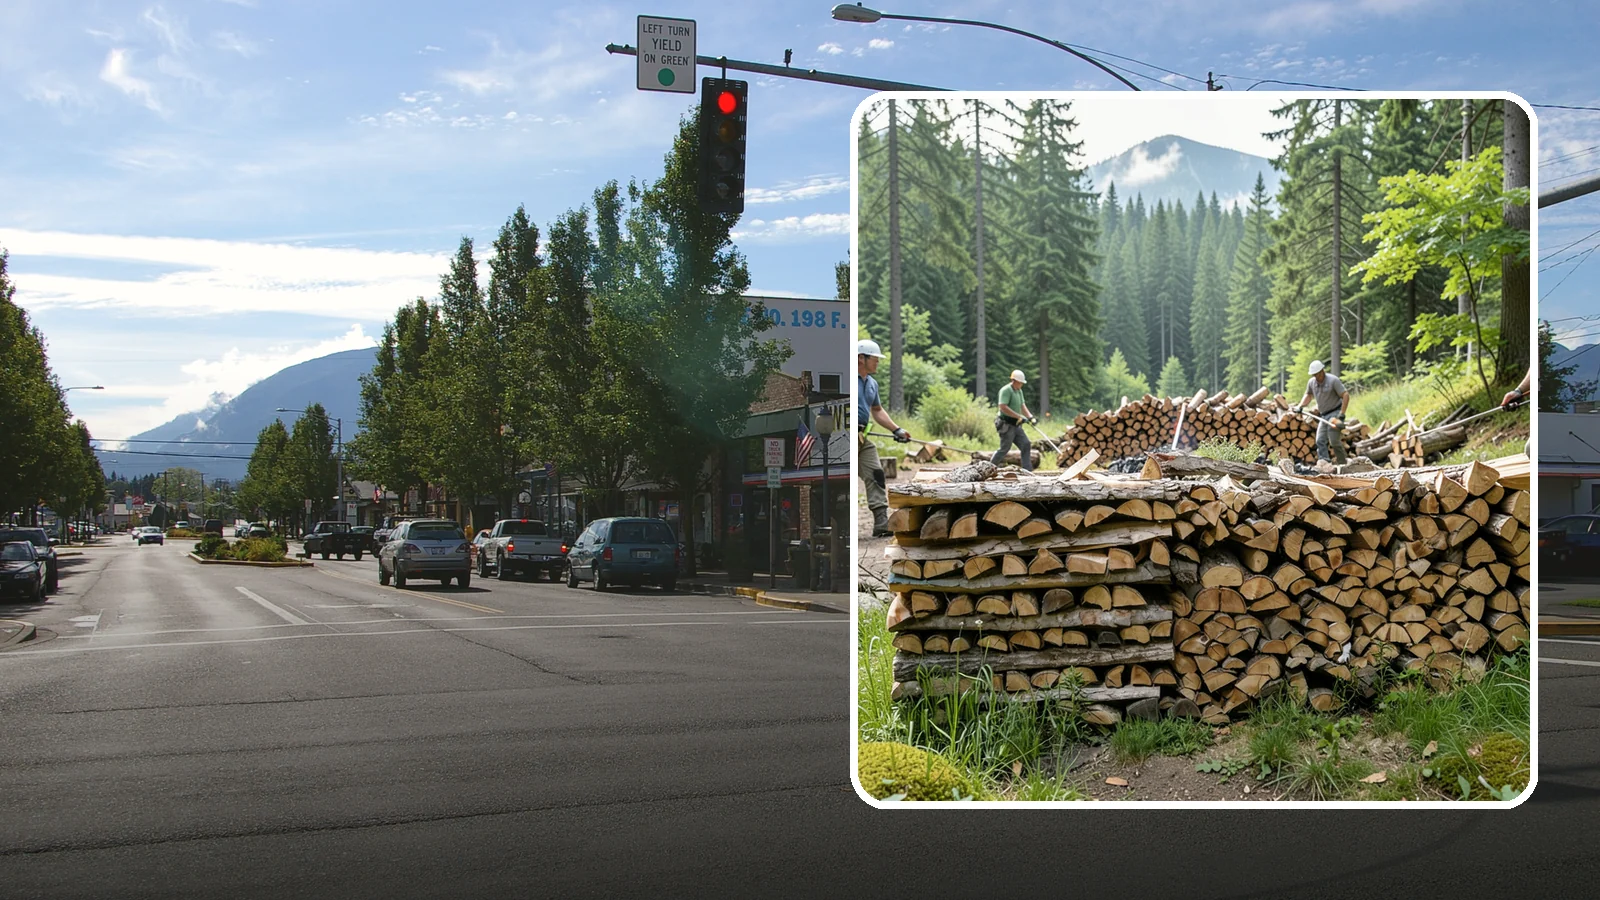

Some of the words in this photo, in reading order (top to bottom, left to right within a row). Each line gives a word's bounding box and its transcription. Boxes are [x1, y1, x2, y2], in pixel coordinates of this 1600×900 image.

[643, 23, 663, 34] LEFT
[668, 25, 690, 36] TURN
[652, 38, 682, 52] YIELD
[644, 53, 656, 64] ON
[661, 55, 689, 66] GREEN
[791, 309, 826, 328] 198
[831, 311, 847, 329] F.
